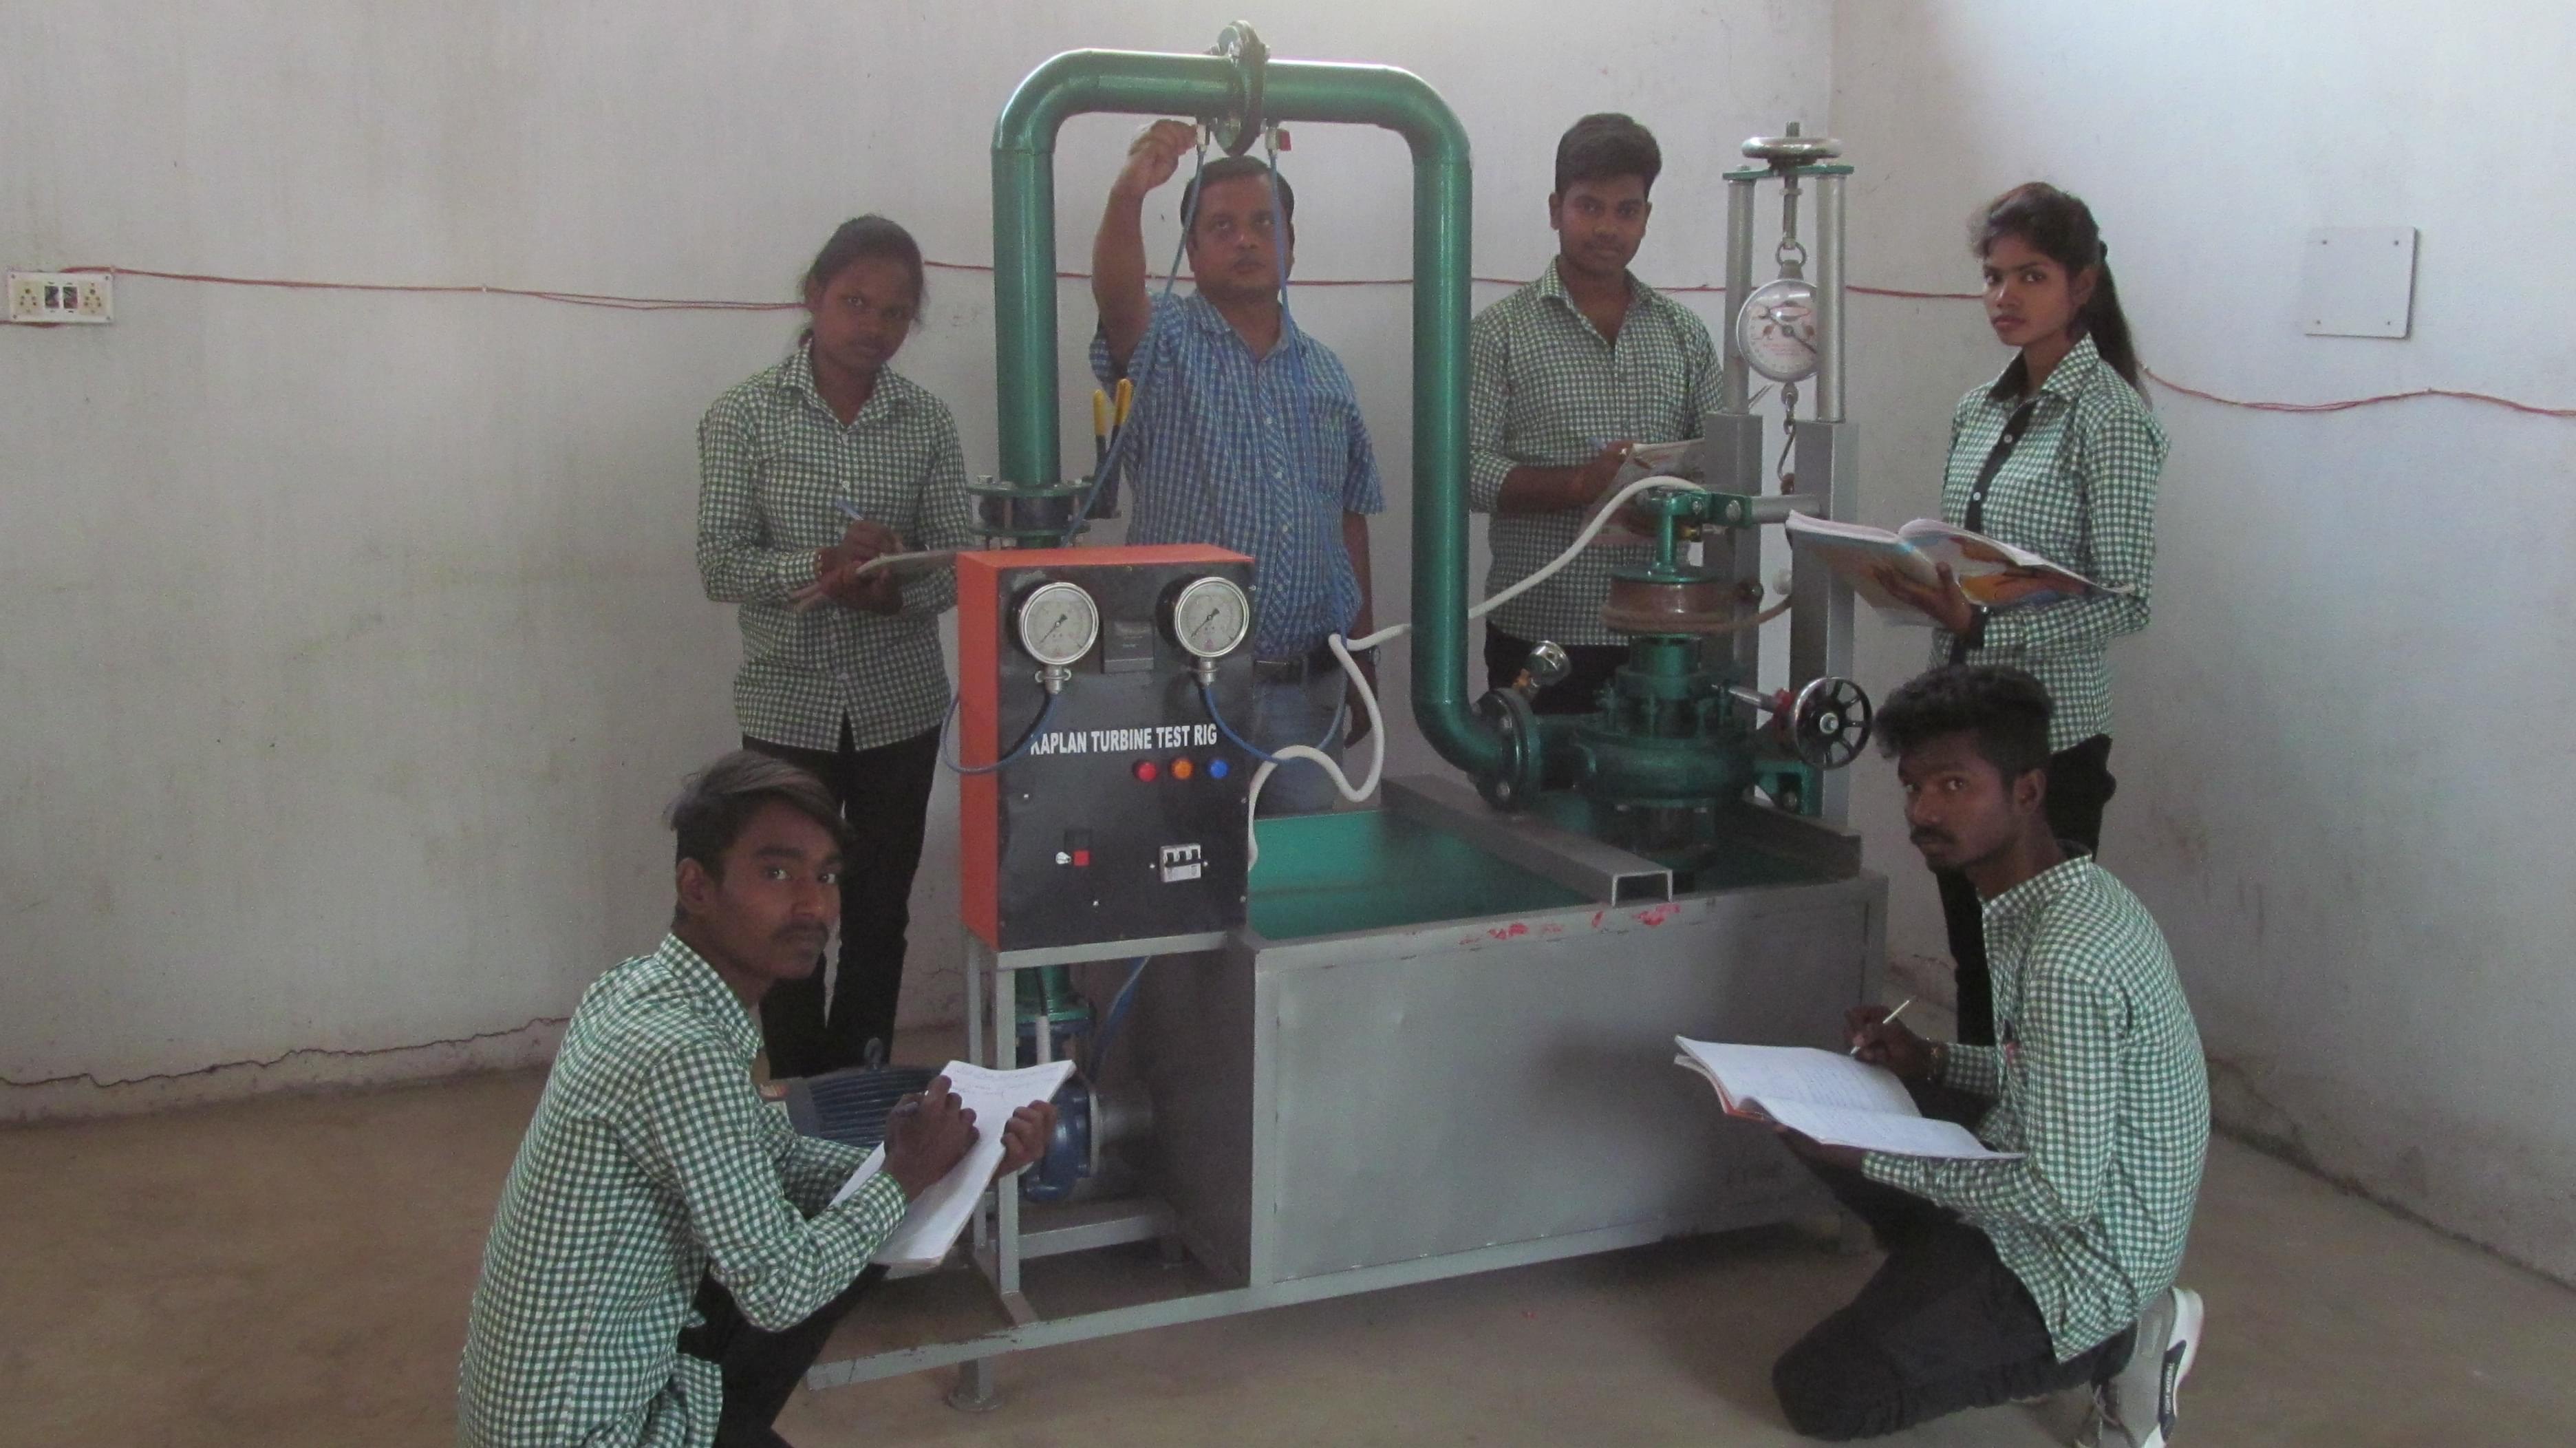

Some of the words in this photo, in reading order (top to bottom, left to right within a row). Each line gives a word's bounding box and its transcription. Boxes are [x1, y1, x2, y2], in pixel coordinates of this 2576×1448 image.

[1091, 727, 1152, 752] TURBINE
[1156, 725, 1190, 749] TEST
[1194, 723, 1217, 746] RIG
